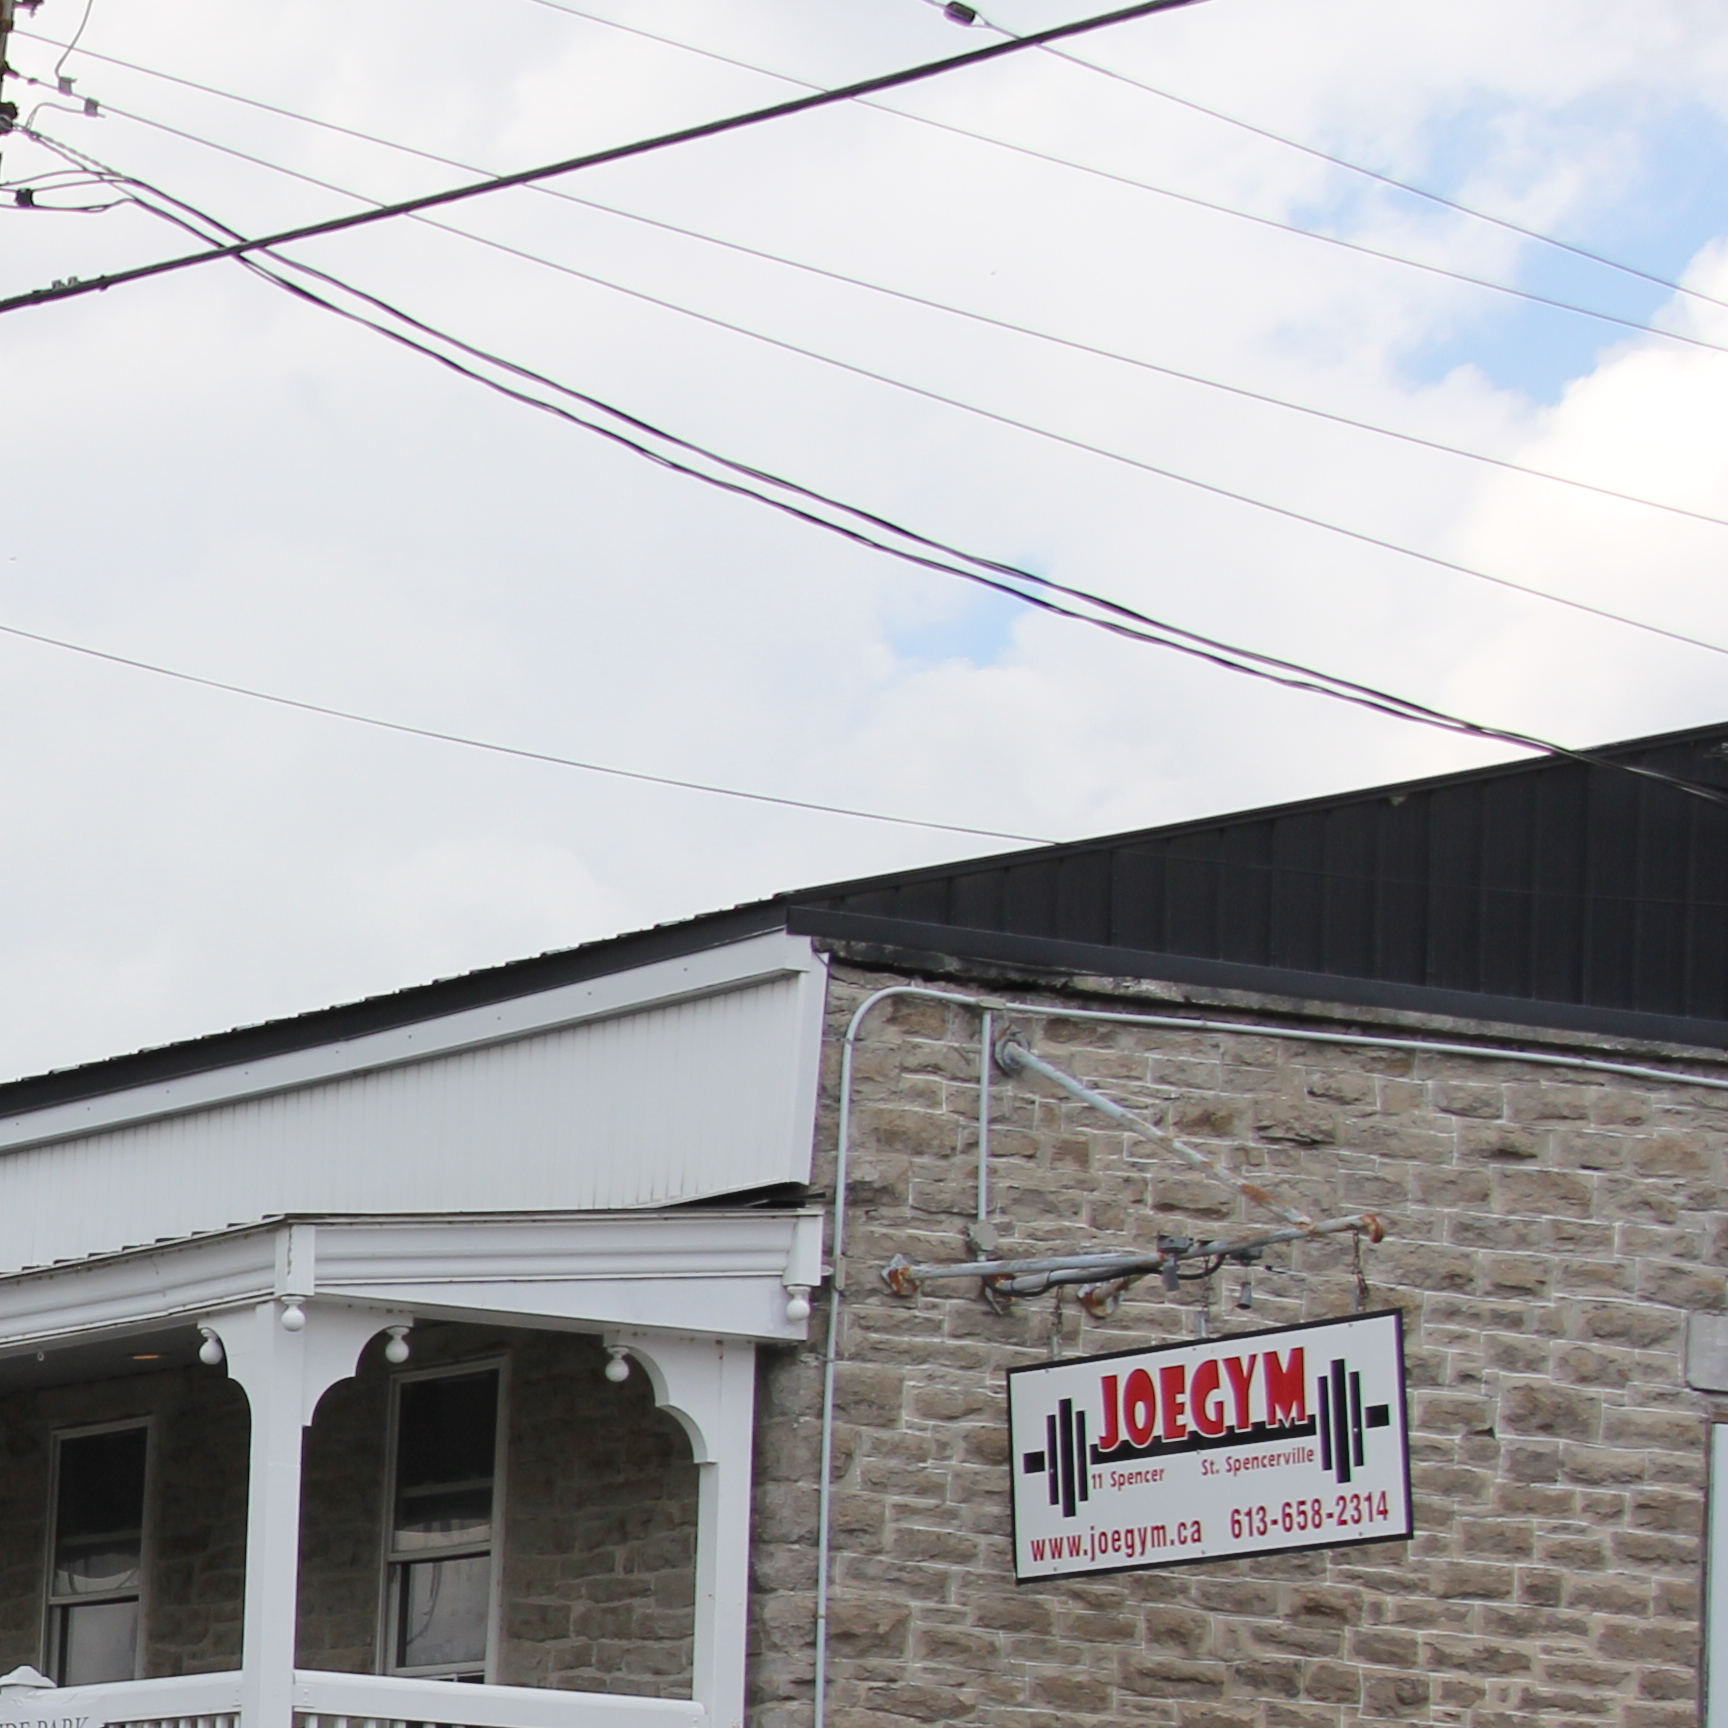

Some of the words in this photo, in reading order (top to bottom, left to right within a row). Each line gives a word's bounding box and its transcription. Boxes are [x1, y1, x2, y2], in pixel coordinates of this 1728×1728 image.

[1099, 1346, 1308, 1451] JOEGYM
[1091, 1474, 1103, 1490] 11
[1110, 1468, 1165, 1491] Spencer
[1201, 1459, 1220, 1476] St.
[1226, 1447, 1315, 1476] Spencerville
[1031, 1517, 1203, 1562] www.joegym.ca
[1230, 1490, 1389, 1540] 613-658-2314
